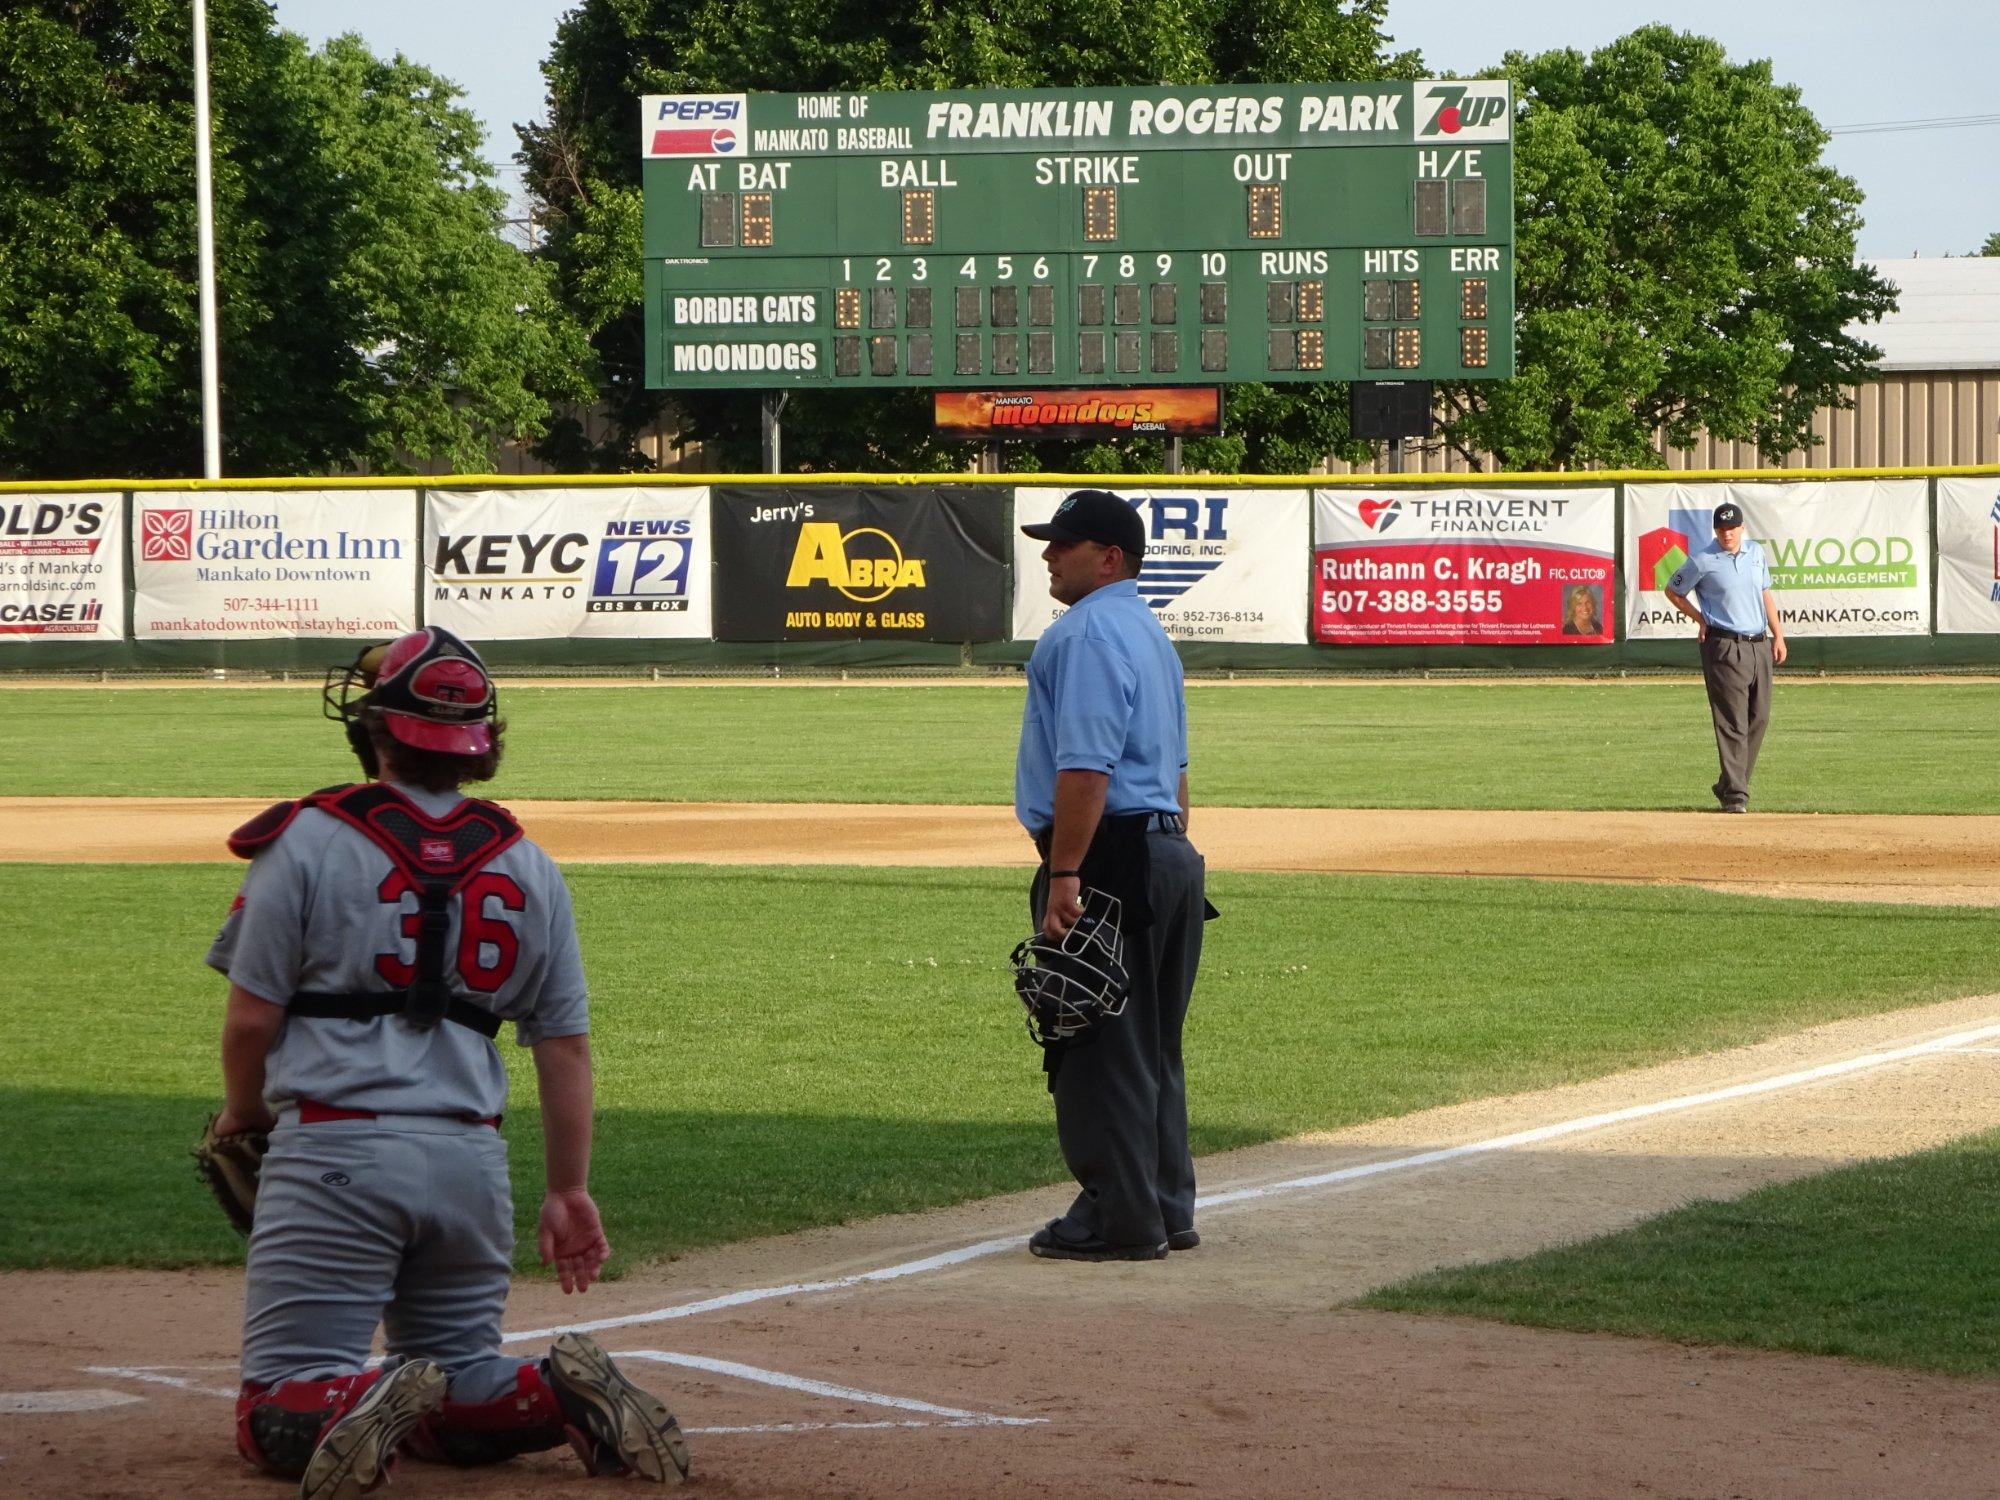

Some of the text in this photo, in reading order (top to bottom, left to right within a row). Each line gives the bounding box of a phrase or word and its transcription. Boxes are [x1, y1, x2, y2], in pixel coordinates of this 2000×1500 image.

[658, 100, 741, 121] PEPSI
[798, 95, 869, 118] HOME OF
[926, 94, 1403, 139] FRANKLIN ROGERS PARK
[754, 127, 913, 151] MANKATO BASEBALL
[881, 160, 958, 188] BALL
[1035, 156, 1140, 185] STRIKE
[1233, 153, 1292, 181] OUT
[1418, 149, 1482, 178] H/E
[687, 162, 792, 191] AT BAT
[843, 248, 1500, 281] 1 2 3 4 5 6 7 8 9 10 RUNS HITS ERR
[674, 295, 816, 324] BORDER CATS
[673, 341, 817, 372] MOONDOGS
[995, 397, 1033, 405] MANKATO
[992, 400, 1153, 428] moondogs
[1132, 422, 1166, 431] BASEBALL
[198, 509, 279, 530] Hilton
[750, 502, 814, 523] Jerry's
[1410, 500, 1570, 517] THRIVENT
[605, 519, 692, 537] NEWS
[196, 531, 402, 561] Garden Inn
[434, 532, 590, 575] KEYC
[1200, 545, 1227, 556] INC.
[1756, 537, 1913, 567] WOOD
[20, 562, 35, 574] of
[39, 561, 103, 575] Mankato
[196, 566, 371, 582] Mankato Downtown
[608, 540, 684, 596] 12
[1322, 558, 1426, 580] Ruthann
[1434, 557, 1459, 580] C.
[1468, 557, 1542, 585] Kragh
[1550, 568, 1568, 580] FIC,
[1803, 572, 1908, 584] MANAGEMENT
[434, 585, 576, 601] MANKATO
[1322, 590, 1503, 613] 507-388-3555
[0, 603, 75, 622] CASE
[223, 597, 319, 612] 507-344-1111
[592, 600, 680, 612] CBS & FOX
[150, 617, 399, 635] mankatodowntown.stayhgi.com
[785, 611, 926, 629] AUTO BODY & GLASS
[1183, 611, 1264, 622] 952-736-8134
[44, 624, 96, 633] AGRICULTURE
[374, 867, 526, 993] 36
